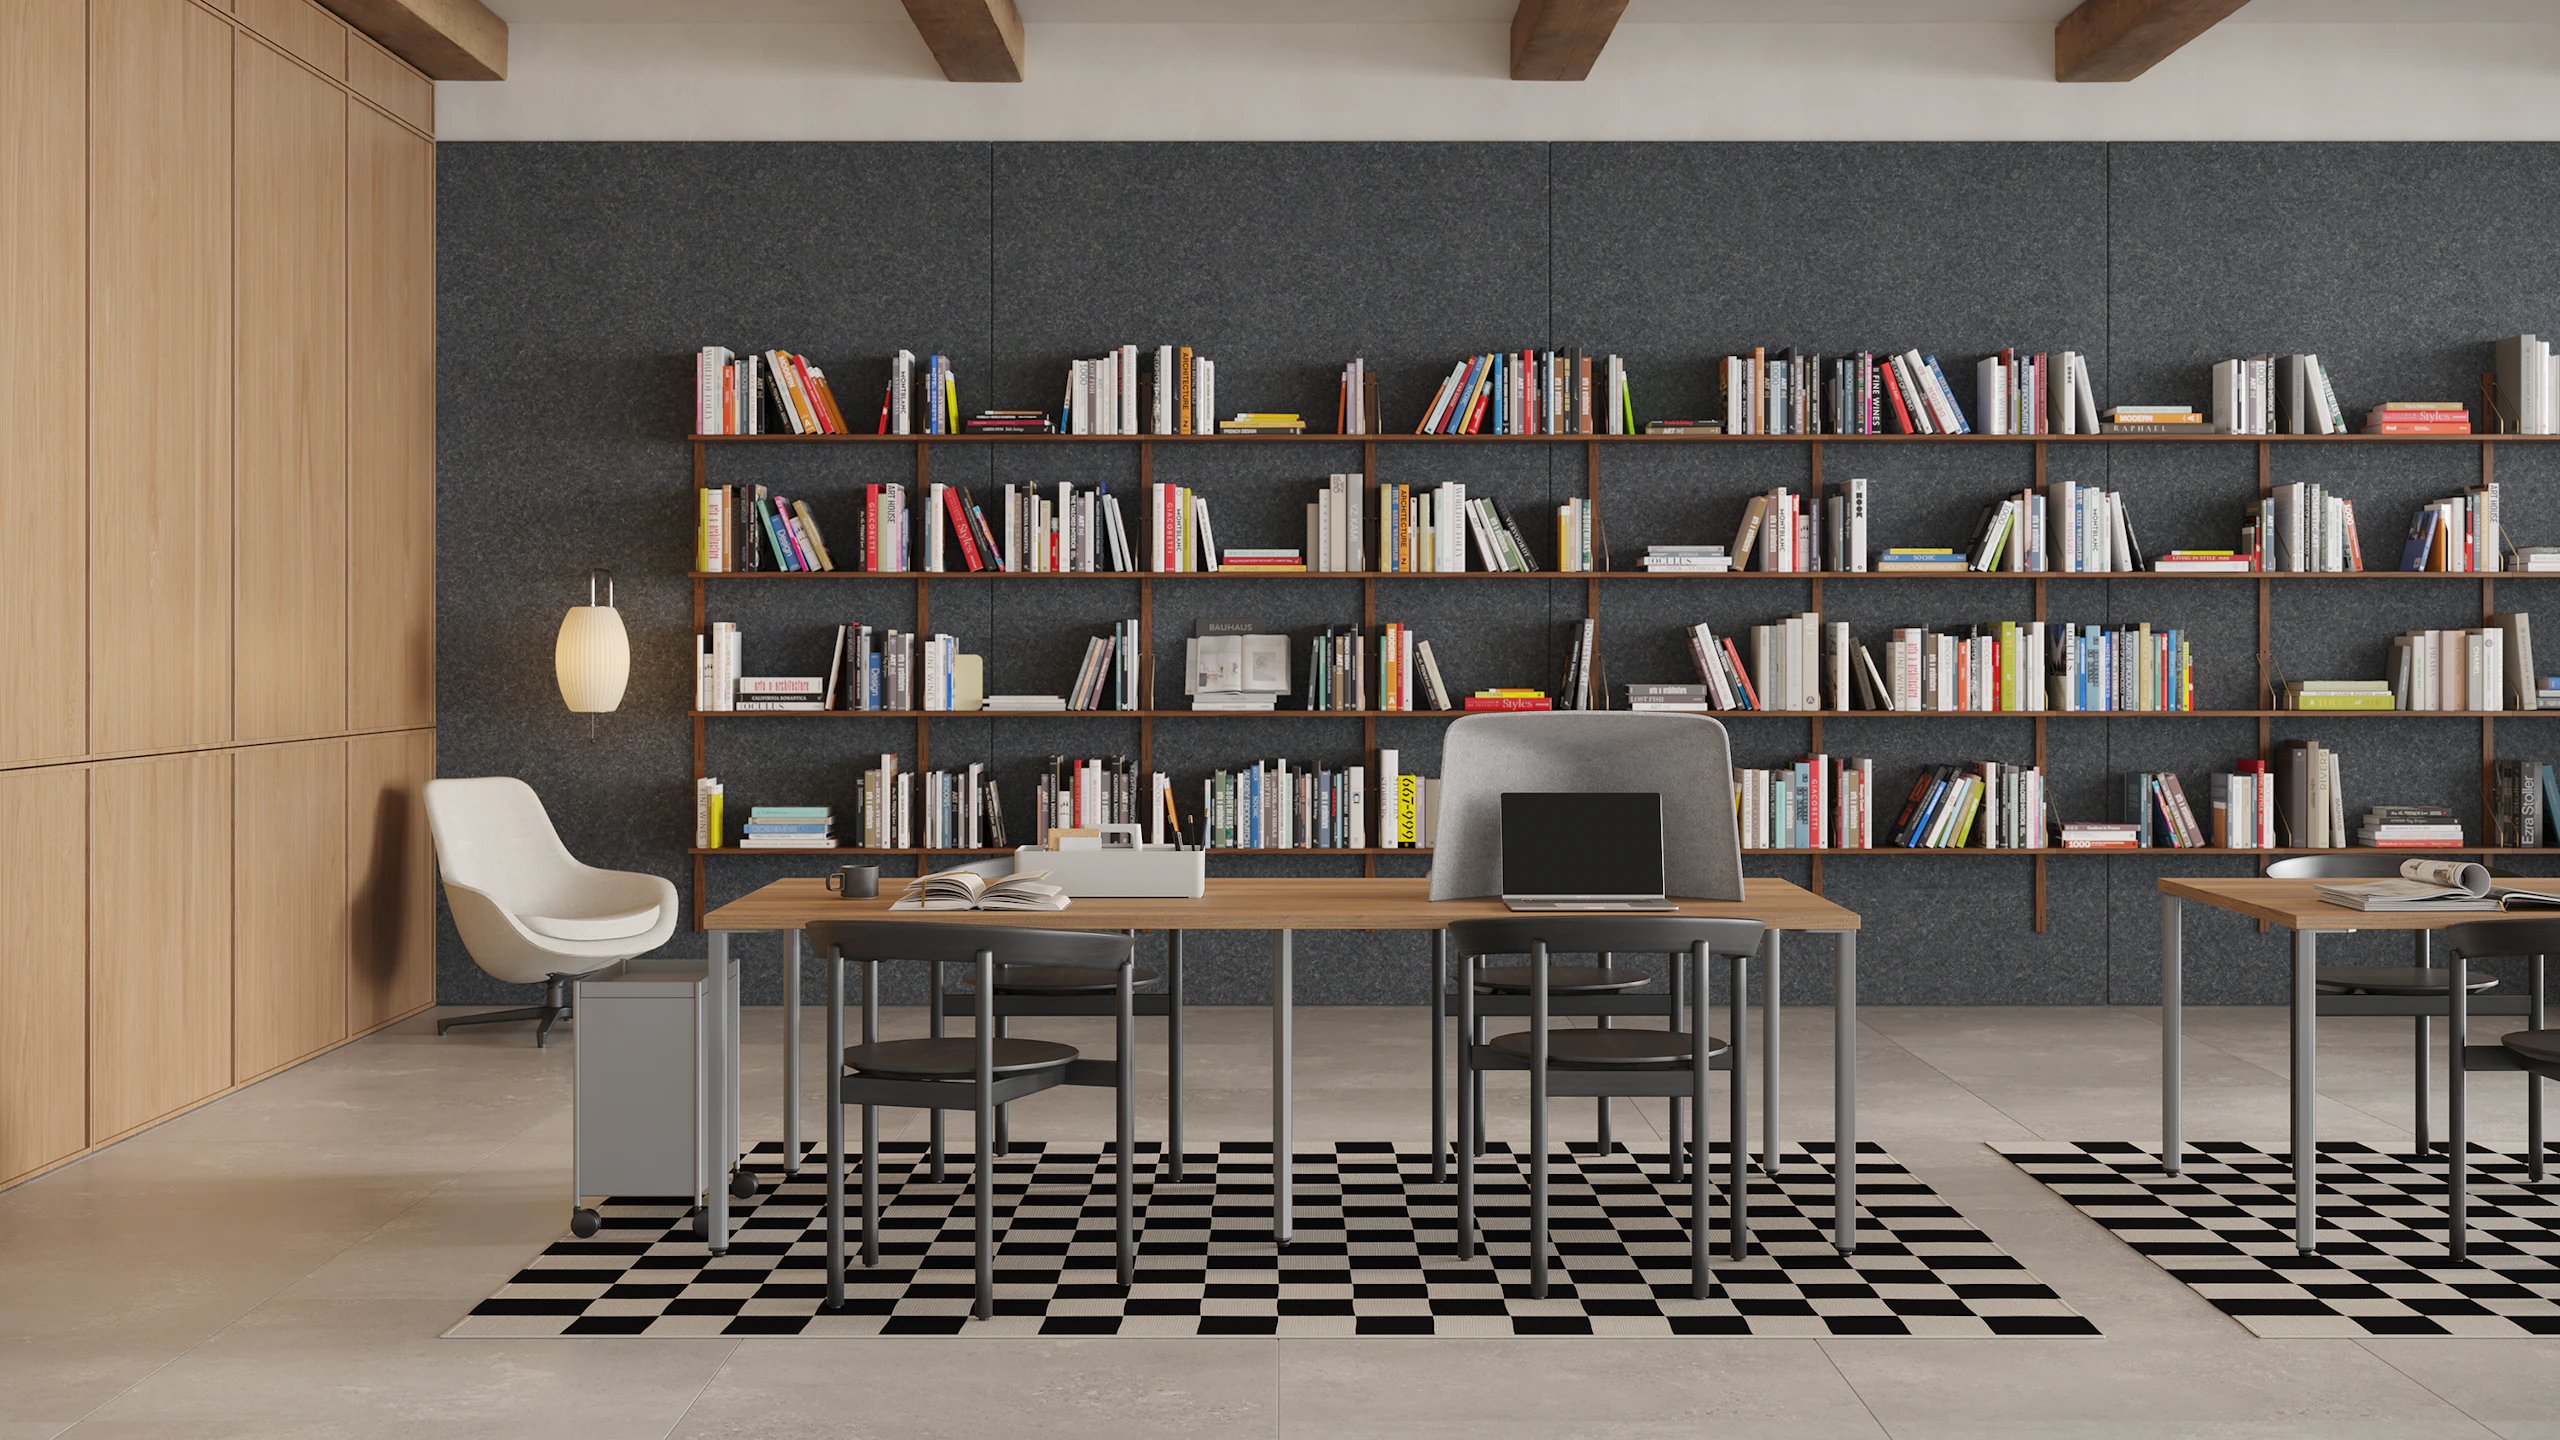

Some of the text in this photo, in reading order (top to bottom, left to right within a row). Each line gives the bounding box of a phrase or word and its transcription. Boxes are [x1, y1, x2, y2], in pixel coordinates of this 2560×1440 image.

[777, 355, 796, 389] MODERN
[1872, 375, 1880, 426] FINE WINES
[2114, 424, 2167, 432] RAPHAEL
[2420, 411, 2450, 423] Styles
[888, 485, 896, 524] ART HOUSE
[1455, 487, 1463, 517] WORLD
[1998, 504, 2012, 526] 1000
[2343, 503, 2354, 526] 1000
[2490, 485, 2498, 524] ART HOUSE
[776, 529, 792, 557] Design
[957, 521, 974, 554] Styles
[1350, 518, 1358, 542] KAMI
[1505, 516, 1530, 558] VERVOORDT
[1651, 557, 1692, 565] OCULUS
[1388, 628, 1396, 662] MODERN
[1580, 623, 1592, 668] DOMESTIC
[871, 668, 880, 696] Design
[1502, 699, 1533, 709] Styles
[1402, 778, 1414, 840] 667-999
[2521, 775, 2534, 844] Ezra Stoller
